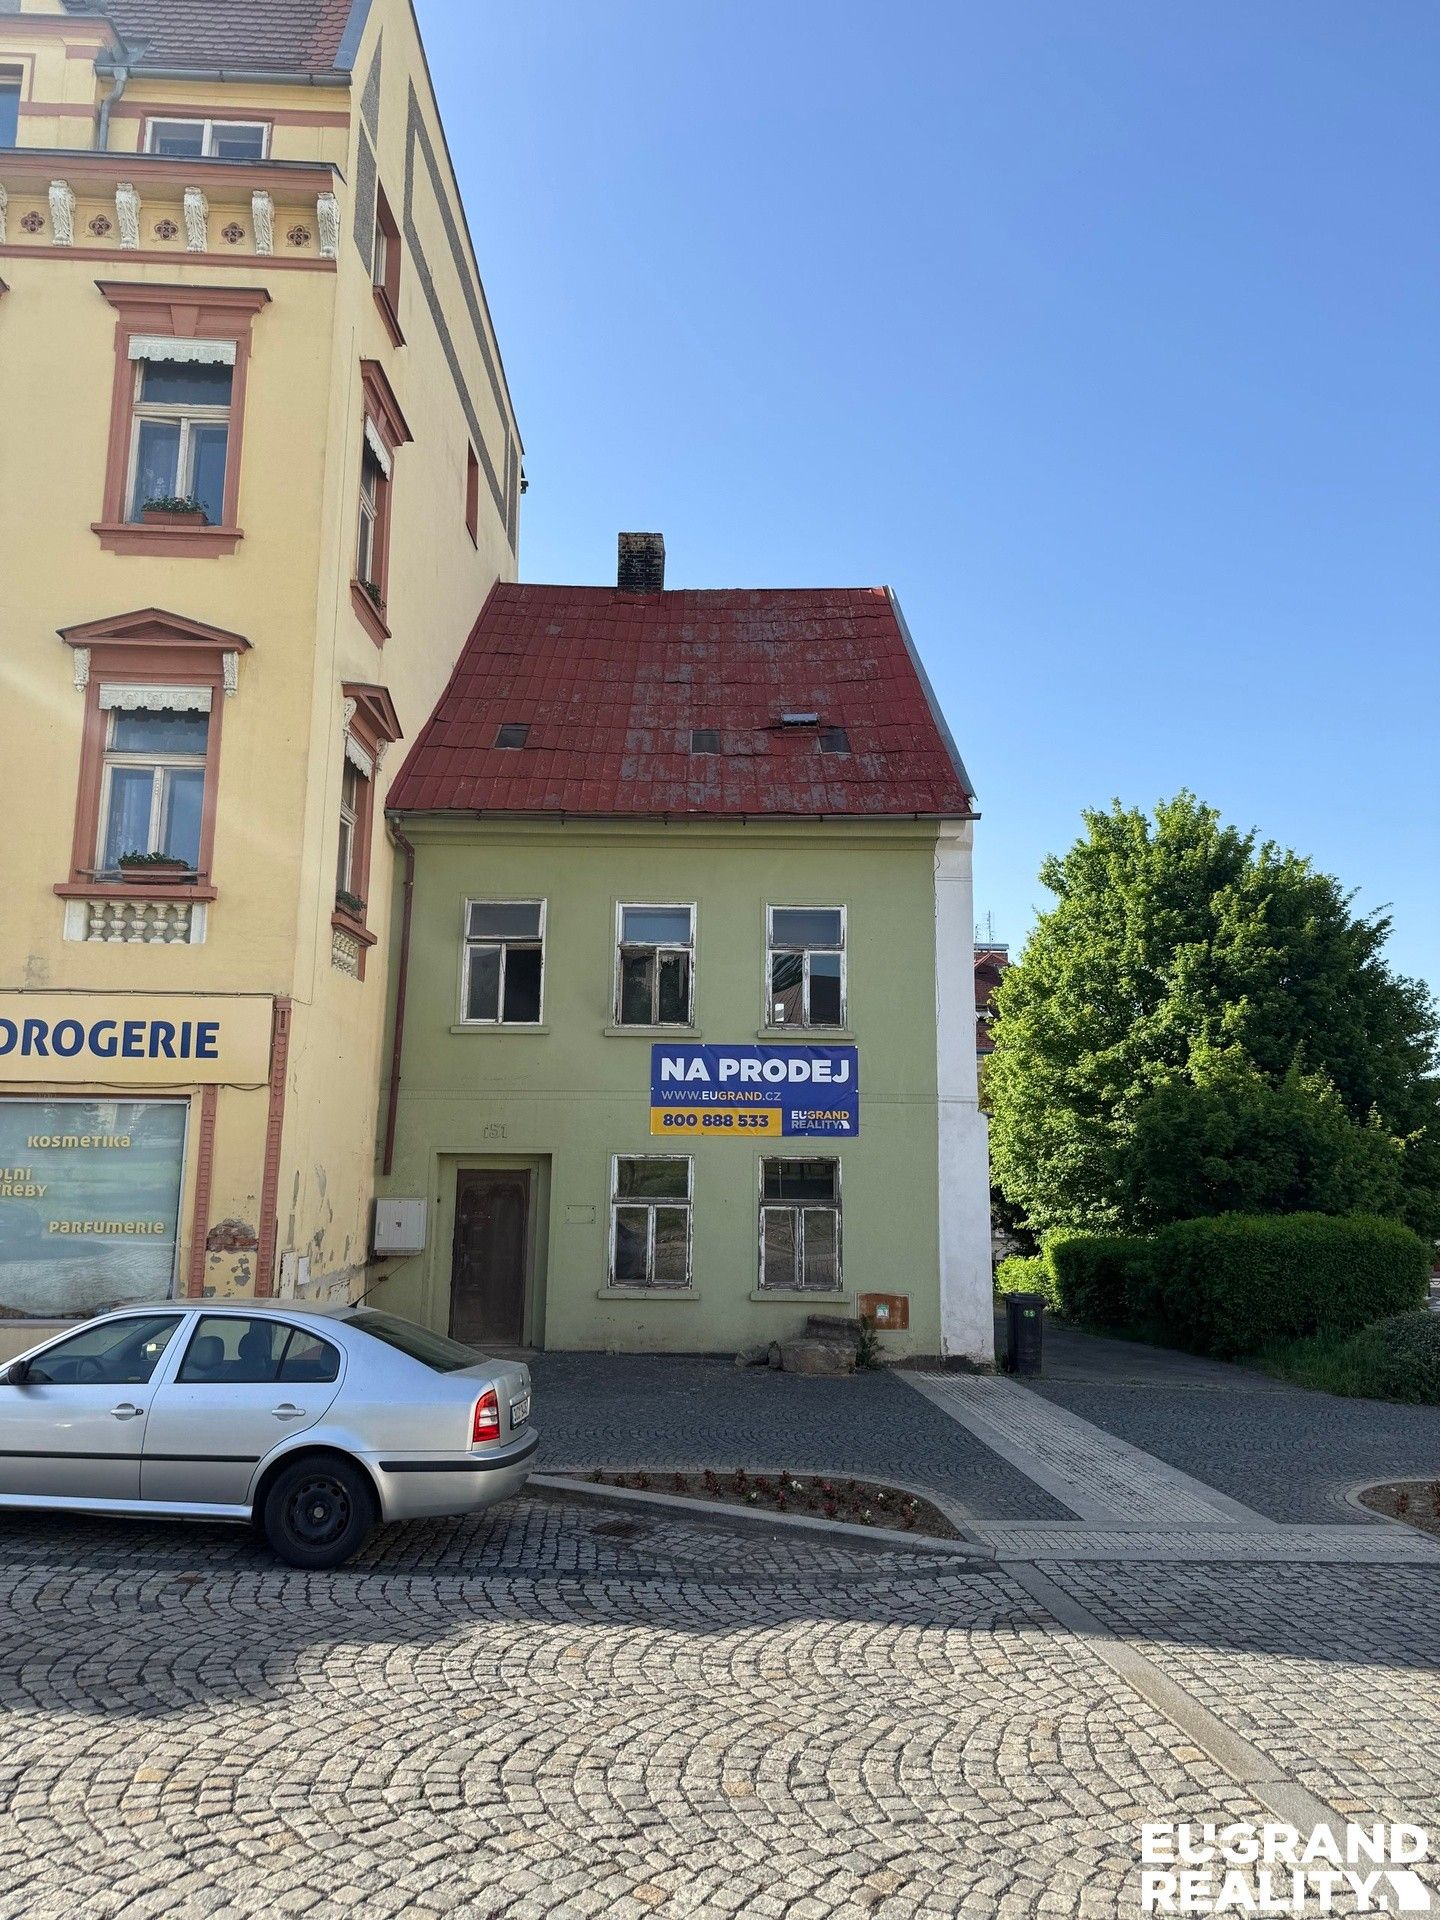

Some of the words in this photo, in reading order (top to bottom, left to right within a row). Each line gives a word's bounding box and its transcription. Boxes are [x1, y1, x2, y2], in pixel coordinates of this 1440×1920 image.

[0, 1018, 220, 1059] DROGERIE
[661, 1057, 710, 1081] NA
[719, 1058, 849, 1083] PRODEJ
[661, 1090, 781, 1101] WWW.EUGRAND.CZ
[663, 1114, 697, 1127] 800
[702, 1114, 733, 1127] 888
[738, 1114, 769, 1128] 533
[791, 1110, 849, 1120] EUGRAND
[791, 1120, 840, 1129] REALITY
